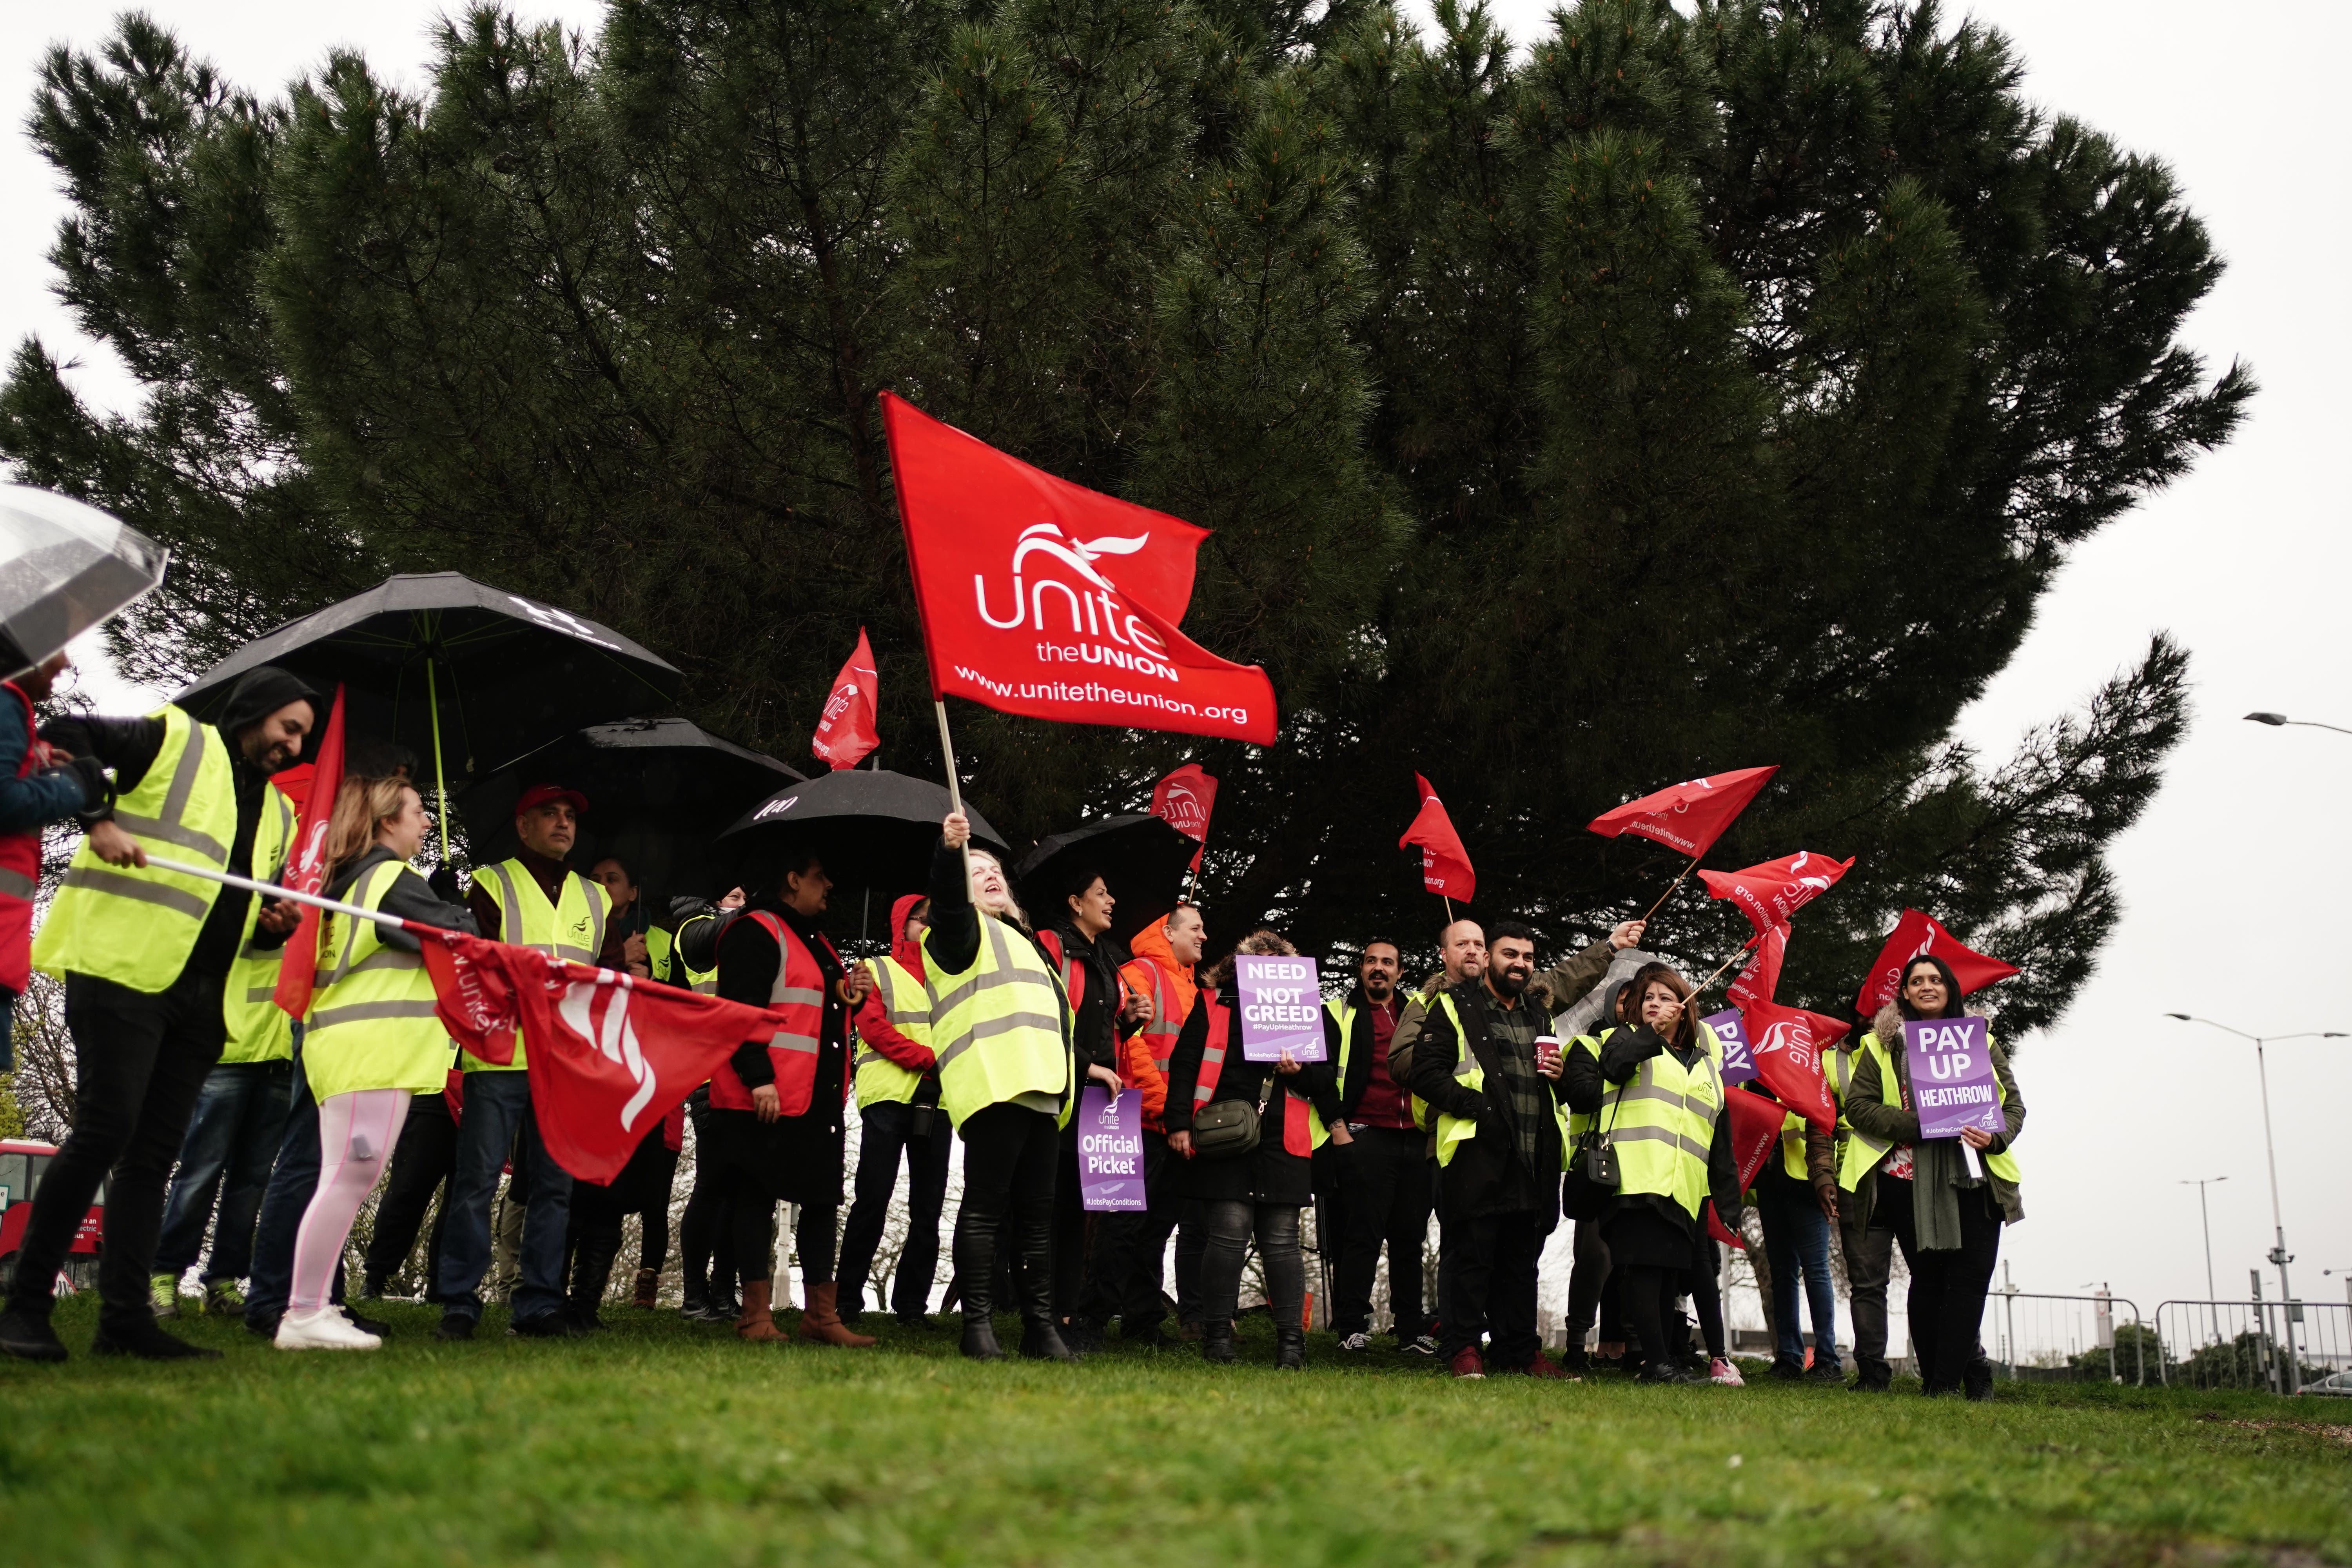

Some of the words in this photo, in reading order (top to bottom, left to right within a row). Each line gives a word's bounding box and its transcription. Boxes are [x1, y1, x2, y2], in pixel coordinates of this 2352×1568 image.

[1036, 641, 1179, 682] theUNION
[955, 665, 1248, 724] www.unitetheunion.org
[1248, 963, 1307, 980] NEED
[1256, 987, 1303, 1004] NOT
[1244, 1005, 1318, 1022] GREED
[1714, 1021, 1751, 1069] PAY
[1918, 1024, 1975, 1053] PAY
[1929, 1053, 1971, 1079] UP
[1919, 1084, 1992, 1107] HEATHROW
[1082, 1134, 1140, 1154] Official
[1088, 1155, 1136, 1174] Picket
[1086, 1198, 1142, 1207] #JobsPayConditions
